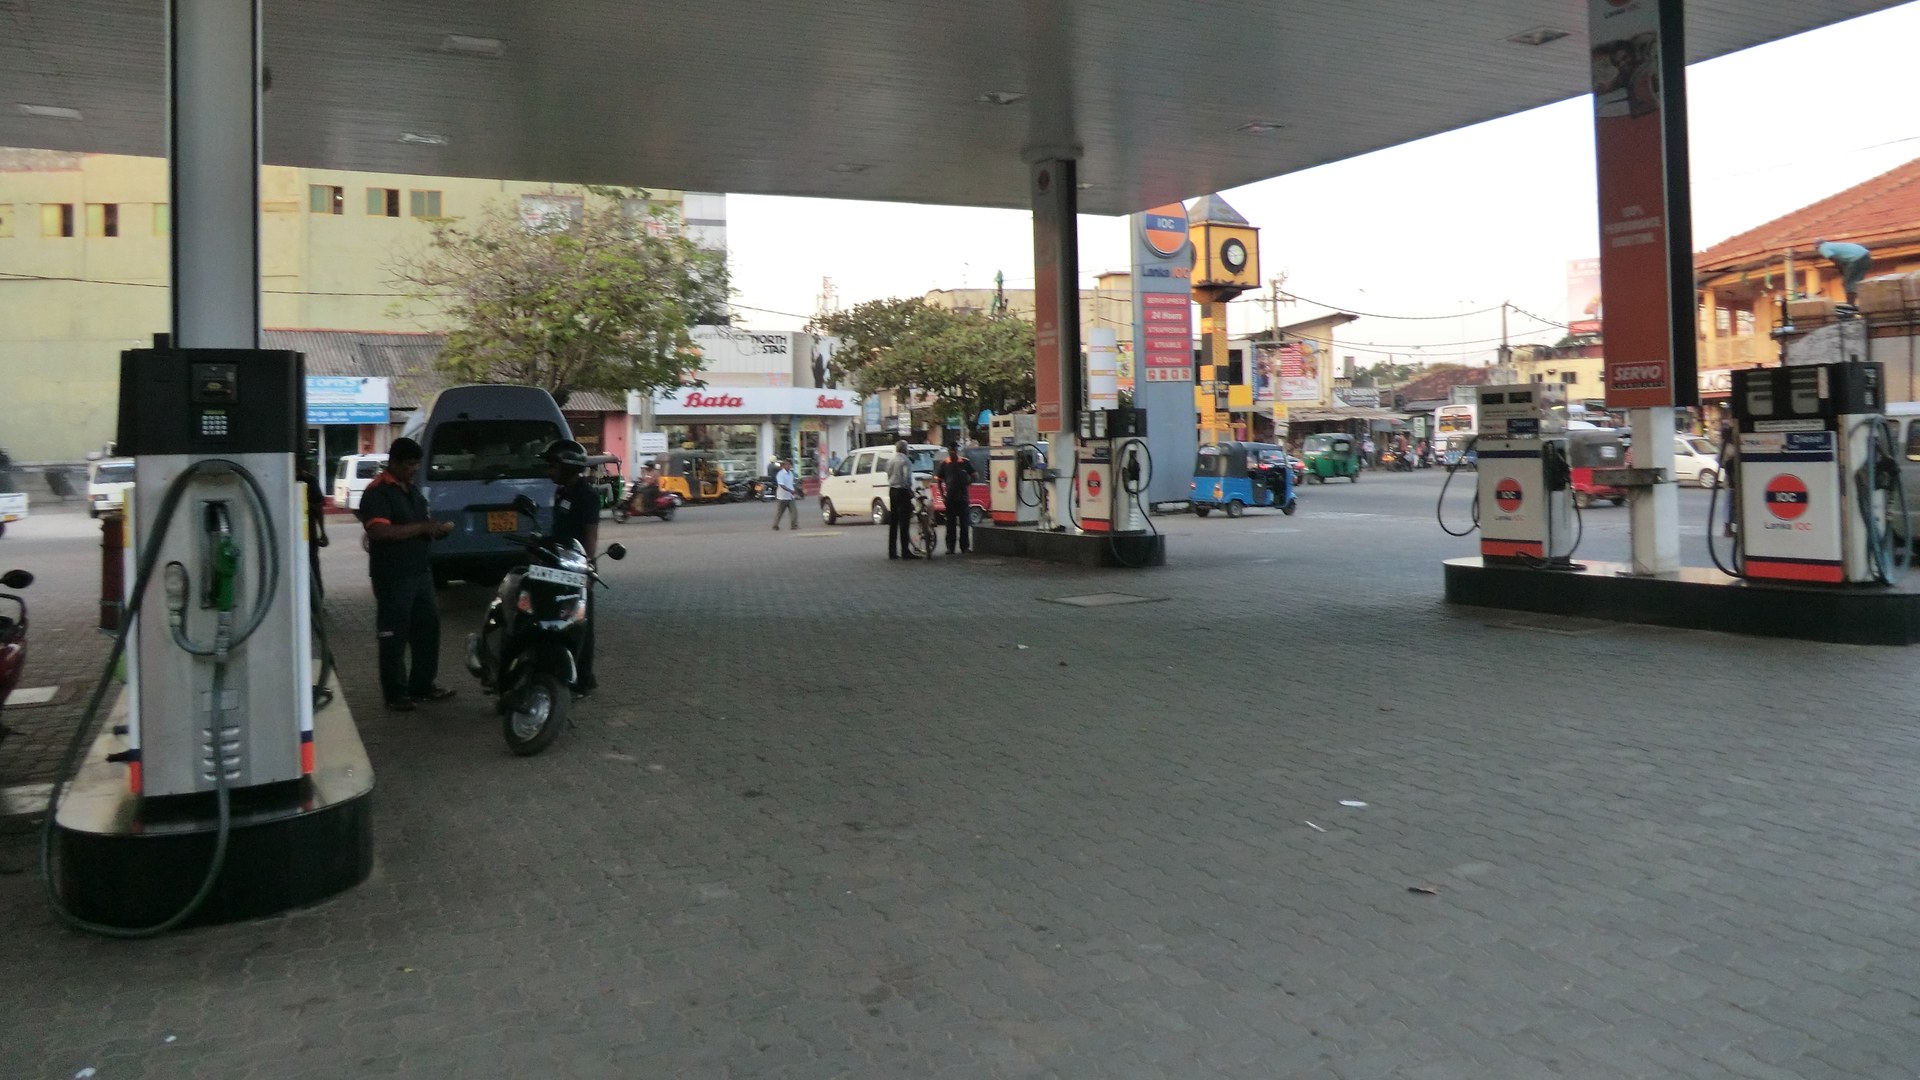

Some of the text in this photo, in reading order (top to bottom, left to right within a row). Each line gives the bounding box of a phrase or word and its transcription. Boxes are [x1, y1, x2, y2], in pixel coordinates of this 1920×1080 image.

[1157, 218, 1175, 230] IOC
[1142, 265, 1170, 278] Lanka
[751, 334, 787, 345] NORTH
[763, 345, 787, 355] STAR
[1615, 366, 1661, 381] SERVO
[683, 392, 743, 408] Bata
[816, 394, 844, 409] Bata
[1776, 492, 1798, 502] IOC
[1765, 522, 1792, 530] Lanka
